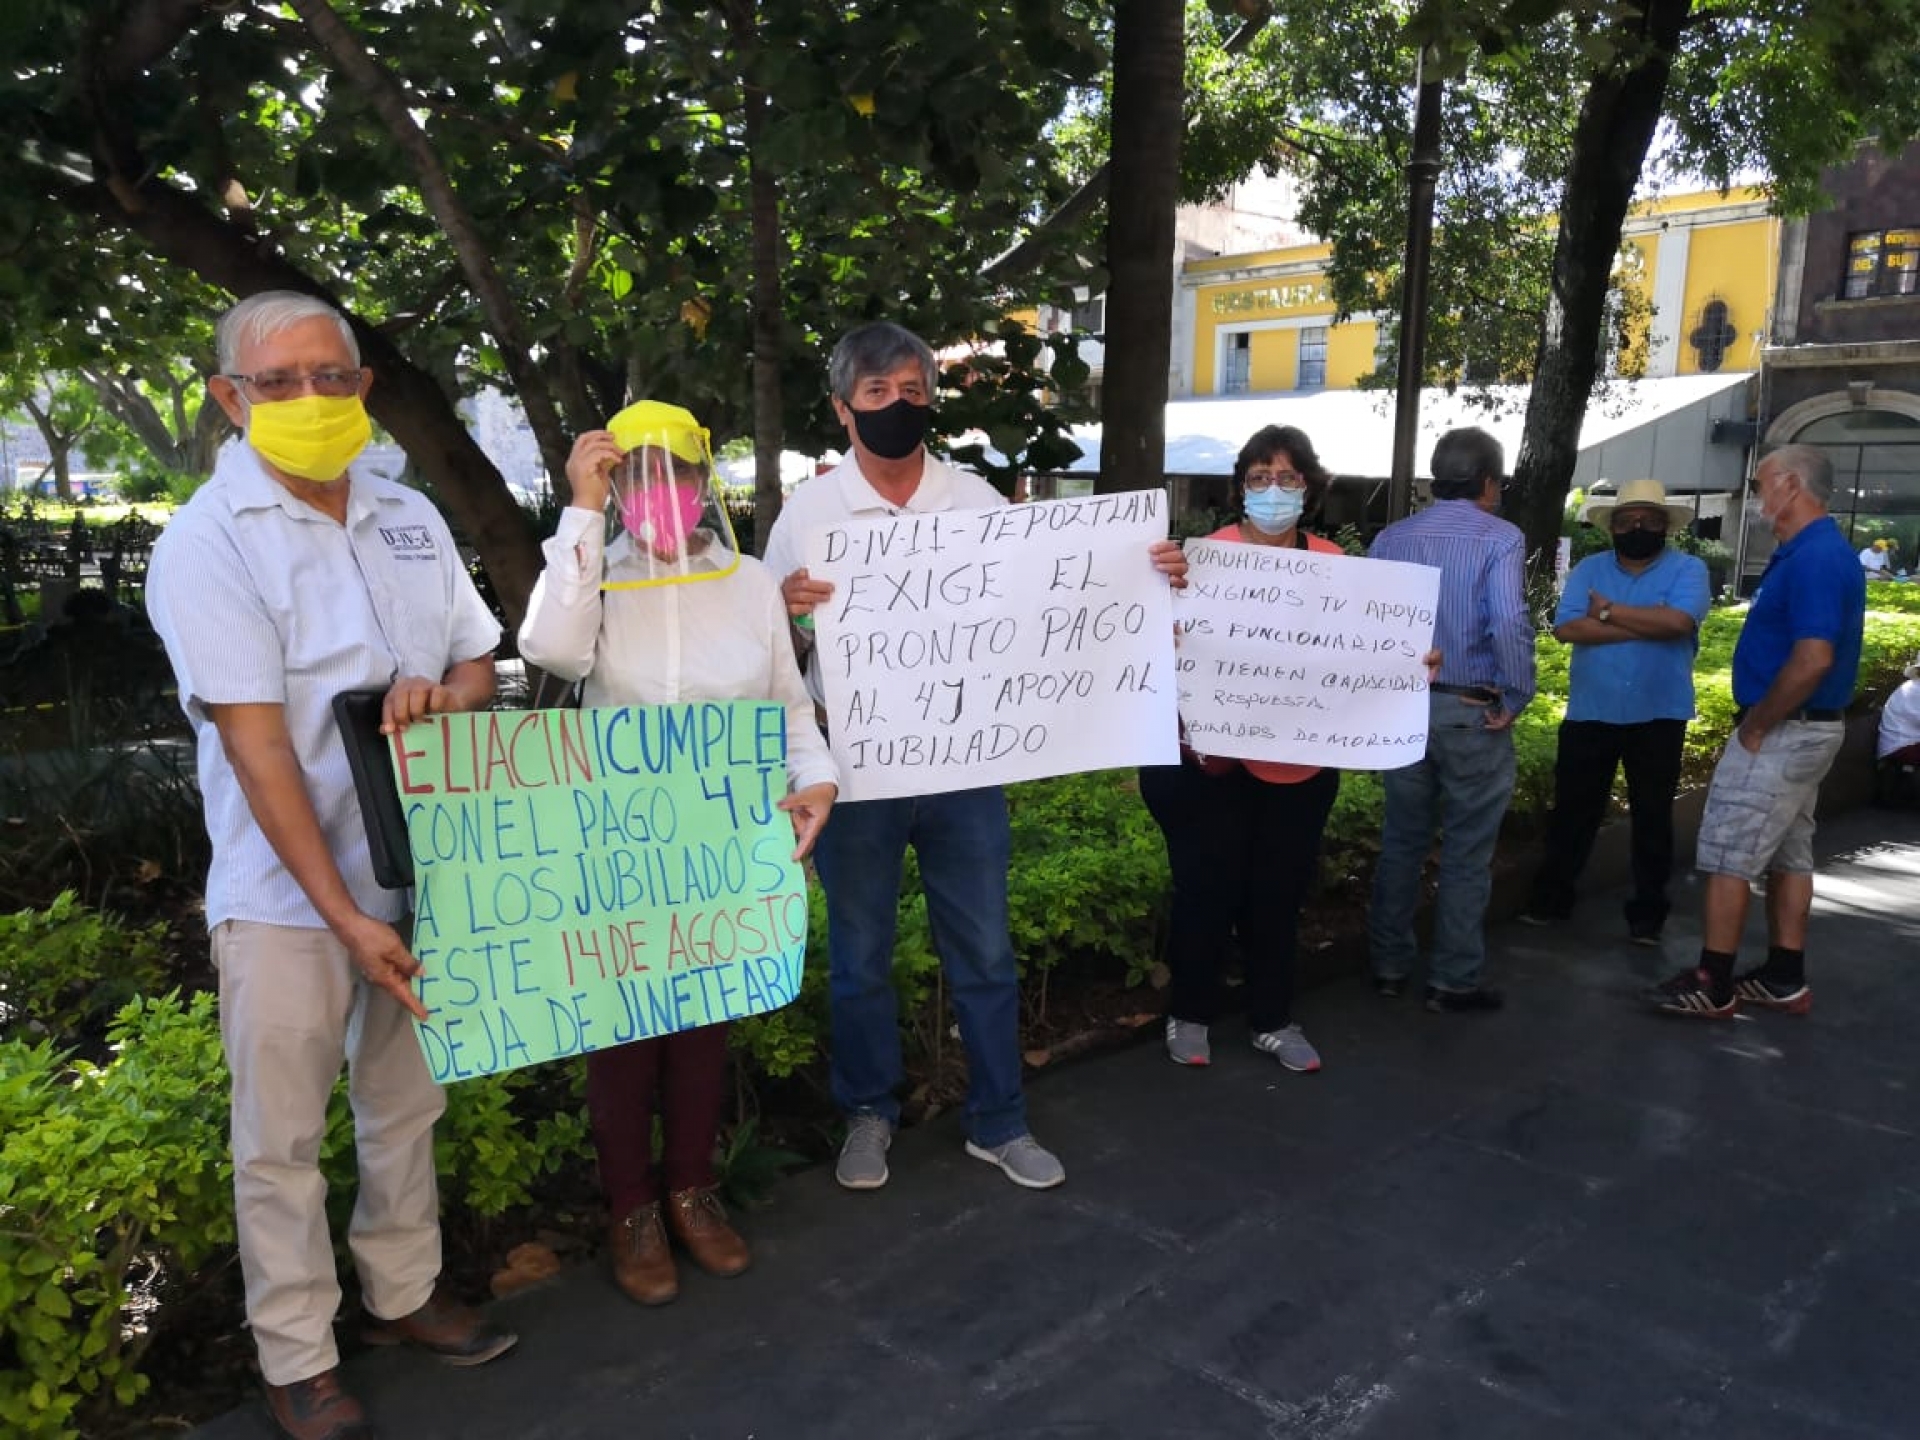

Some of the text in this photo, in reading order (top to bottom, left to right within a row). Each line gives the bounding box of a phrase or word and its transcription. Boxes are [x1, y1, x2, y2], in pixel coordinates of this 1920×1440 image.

[978, 490, 1158, 543] TEPOZTLAN
[840, 550, 1107, 622] EXIGE EL
[838, 602, 1145, 678] PRONTO PAGO
[1175, 618, 1416, 658] US FUNCIONARIOS
[1215, 659, 1306, 681] TIENEN
[845, 687, 888, 732] AL
[1116, 662, 1157, 693] AL
[392, 712, 593, 795] ELIACIN
[573, 786, 678, 849] PAGO
[414, 836, 786, 944] A LOS JUBILADOS
[419, 938, 541, 1013] ESTE
[668, 892, 808, 970] AGOSTO
[419, 1007, 531, 1081] DEJA
[547, 993, 596, 1057] DE
